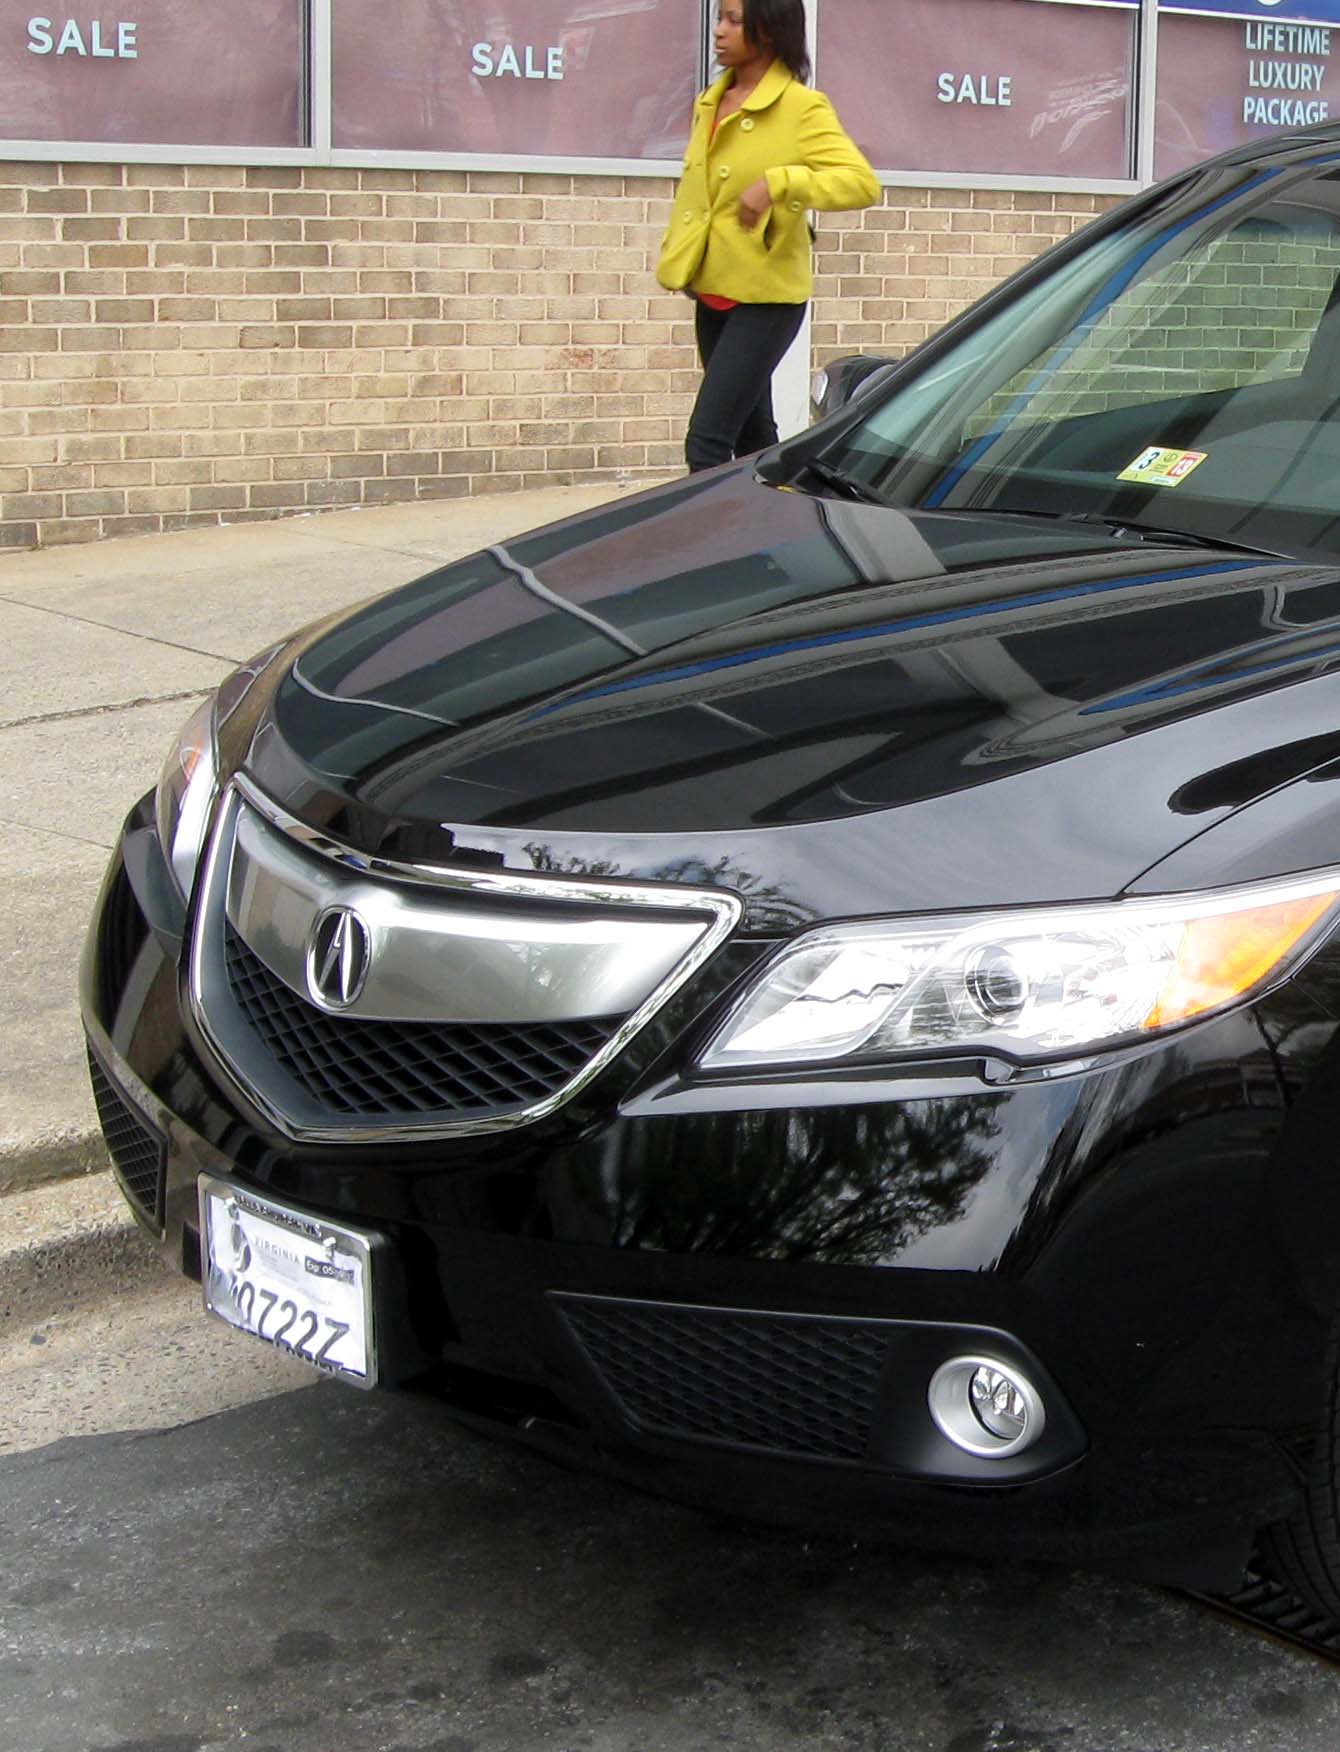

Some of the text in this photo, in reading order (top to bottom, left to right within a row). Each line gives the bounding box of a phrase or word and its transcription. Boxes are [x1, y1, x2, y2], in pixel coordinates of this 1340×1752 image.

[27, 16, 138, 58] SALE
[1246, 22, 1331, 55] LIFETIME
[471, 42, 564, 80] SALE
[1249, 59, 1325, 91] LUXURY
[937, 72, 1012, 106] SALE
[1243, 96, 1329, 126] PACKAGE
